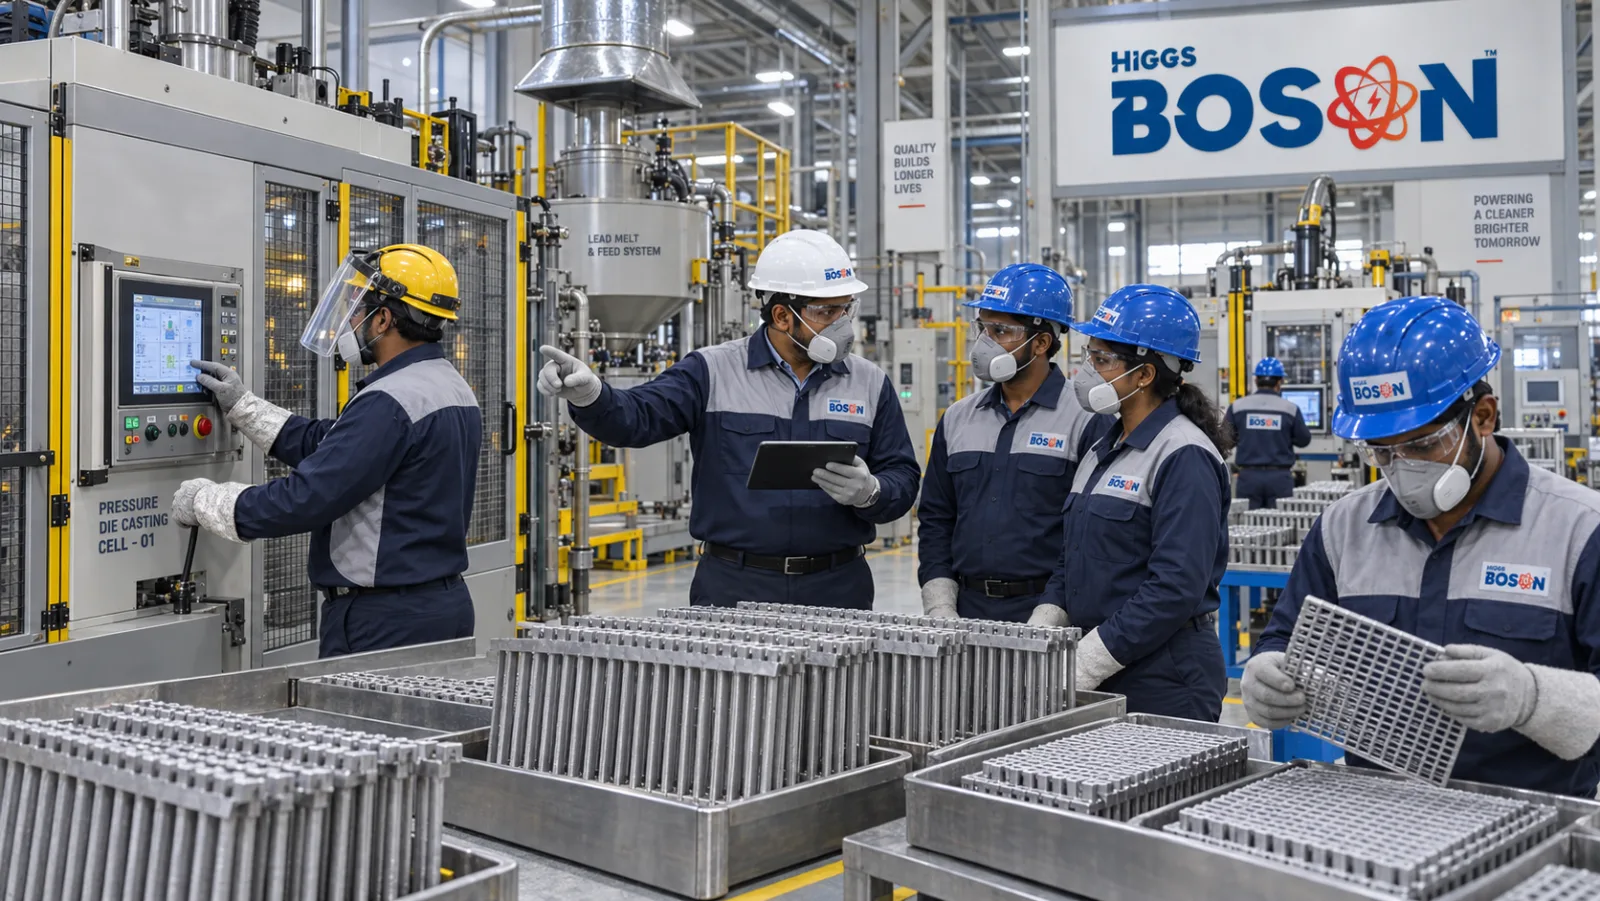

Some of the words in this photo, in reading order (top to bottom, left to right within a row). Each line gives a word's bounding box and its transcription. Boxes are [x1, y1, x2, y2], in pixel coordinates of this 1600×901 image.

[1111, 55, 1498, 156] BOSON
[894, 143, 936, 155] QUALITY
[894, 156, 930, 168] BUILDS
[894, 169, 934, 181] LONGER
[894, 183, 922, 194] LIVES
[1474, 193, 1533, 206] POWERING
[1474, 209, 1482, 220] A
[1485, 208, 1535, 220] CLEANER
[1474, 222, 1529, 234] BRIGHTER
[588, 234, 612, 244] LEAD
[614, 233, 639, 243] MELT
[1474, 236, 1541, 248] TOMORROW
[588, 247, 595, 257] &
[597, 246, 621, 256] FEED
[623, 246, 661, 256] SYSTEM
[1354, 382, 1405, 400] BOSON
[829, 403, 864, 414] BOSON
[1030, 436, 1064, 449] BOSON
[1107, 478, 1140, 492] BOSON
[99, 496, 159, 515] PRESSURE
[99, 519, 118, 534] DIE
[121, 513, 168, 532] CASTING
[98, 537, 128, 554] CELL
[140, 533, 154, 548] 01
[1485, 571, 1546, 591] BOSON
